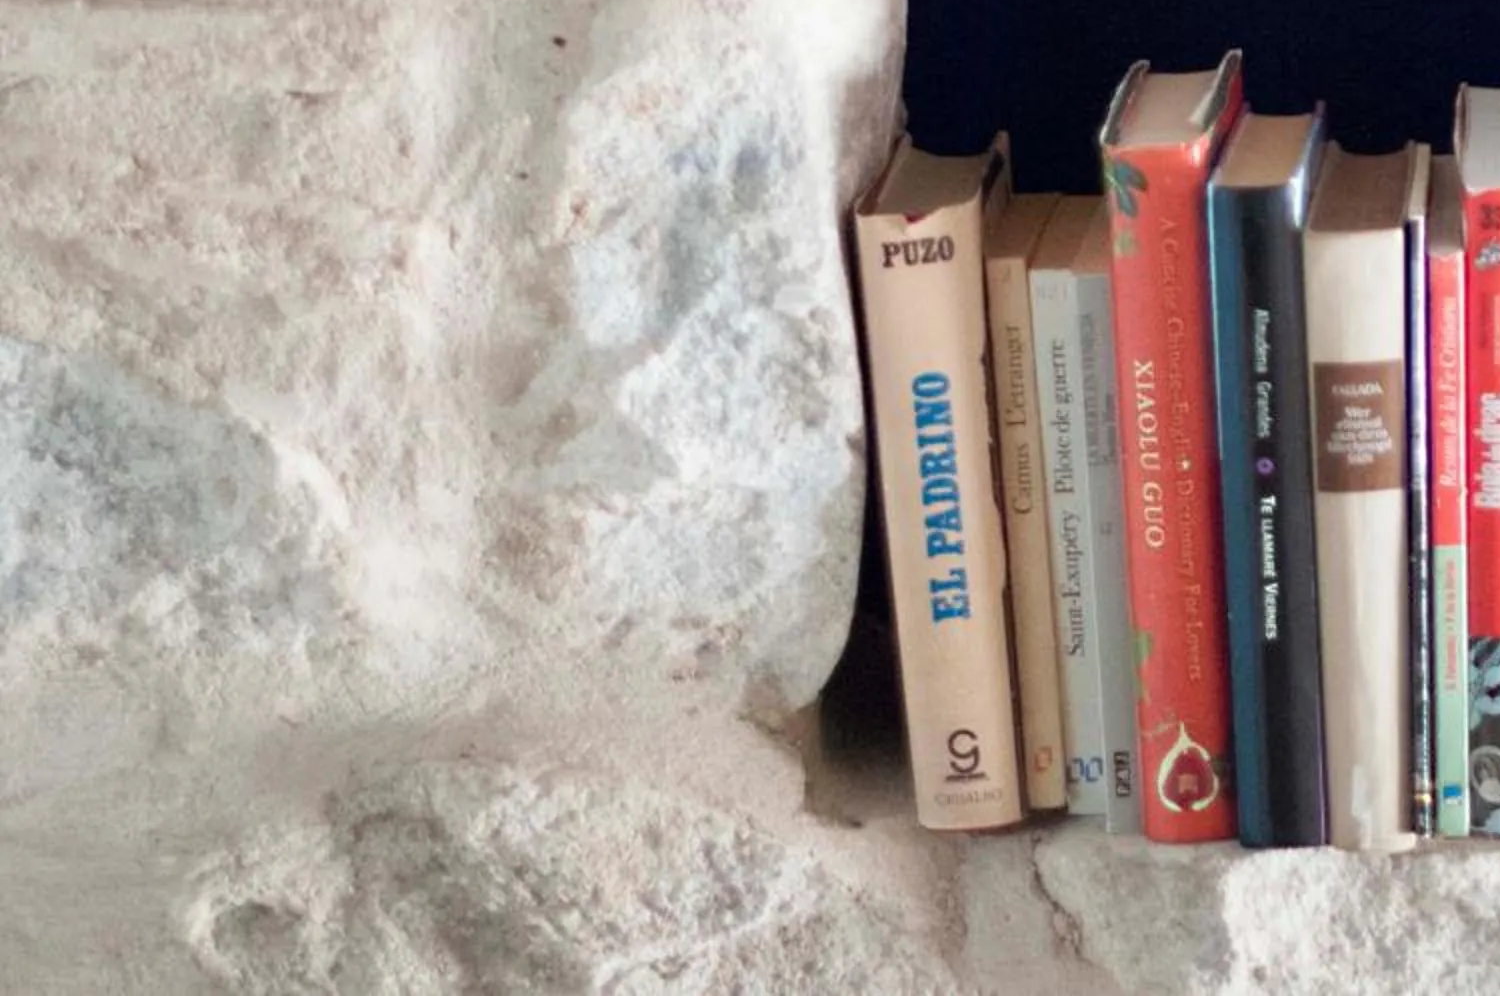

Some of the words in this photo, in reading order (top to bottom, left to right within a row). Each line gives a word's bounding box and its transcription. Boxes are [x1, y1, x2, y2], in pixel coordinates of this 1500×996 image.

[881, 235, 956, 269] PUZO
[1051, 409, 1073, 433] de
[1133, 359, 1163, 472] XIAOLU
[1256, 380, 1273, 439] Grandes
[911, 370, 967, 559] PADRINO
[1009, 442, 1035, 515] Camus
[1143, 481, 1166, 549] GUO
[928, 567, 973, 627] EL
